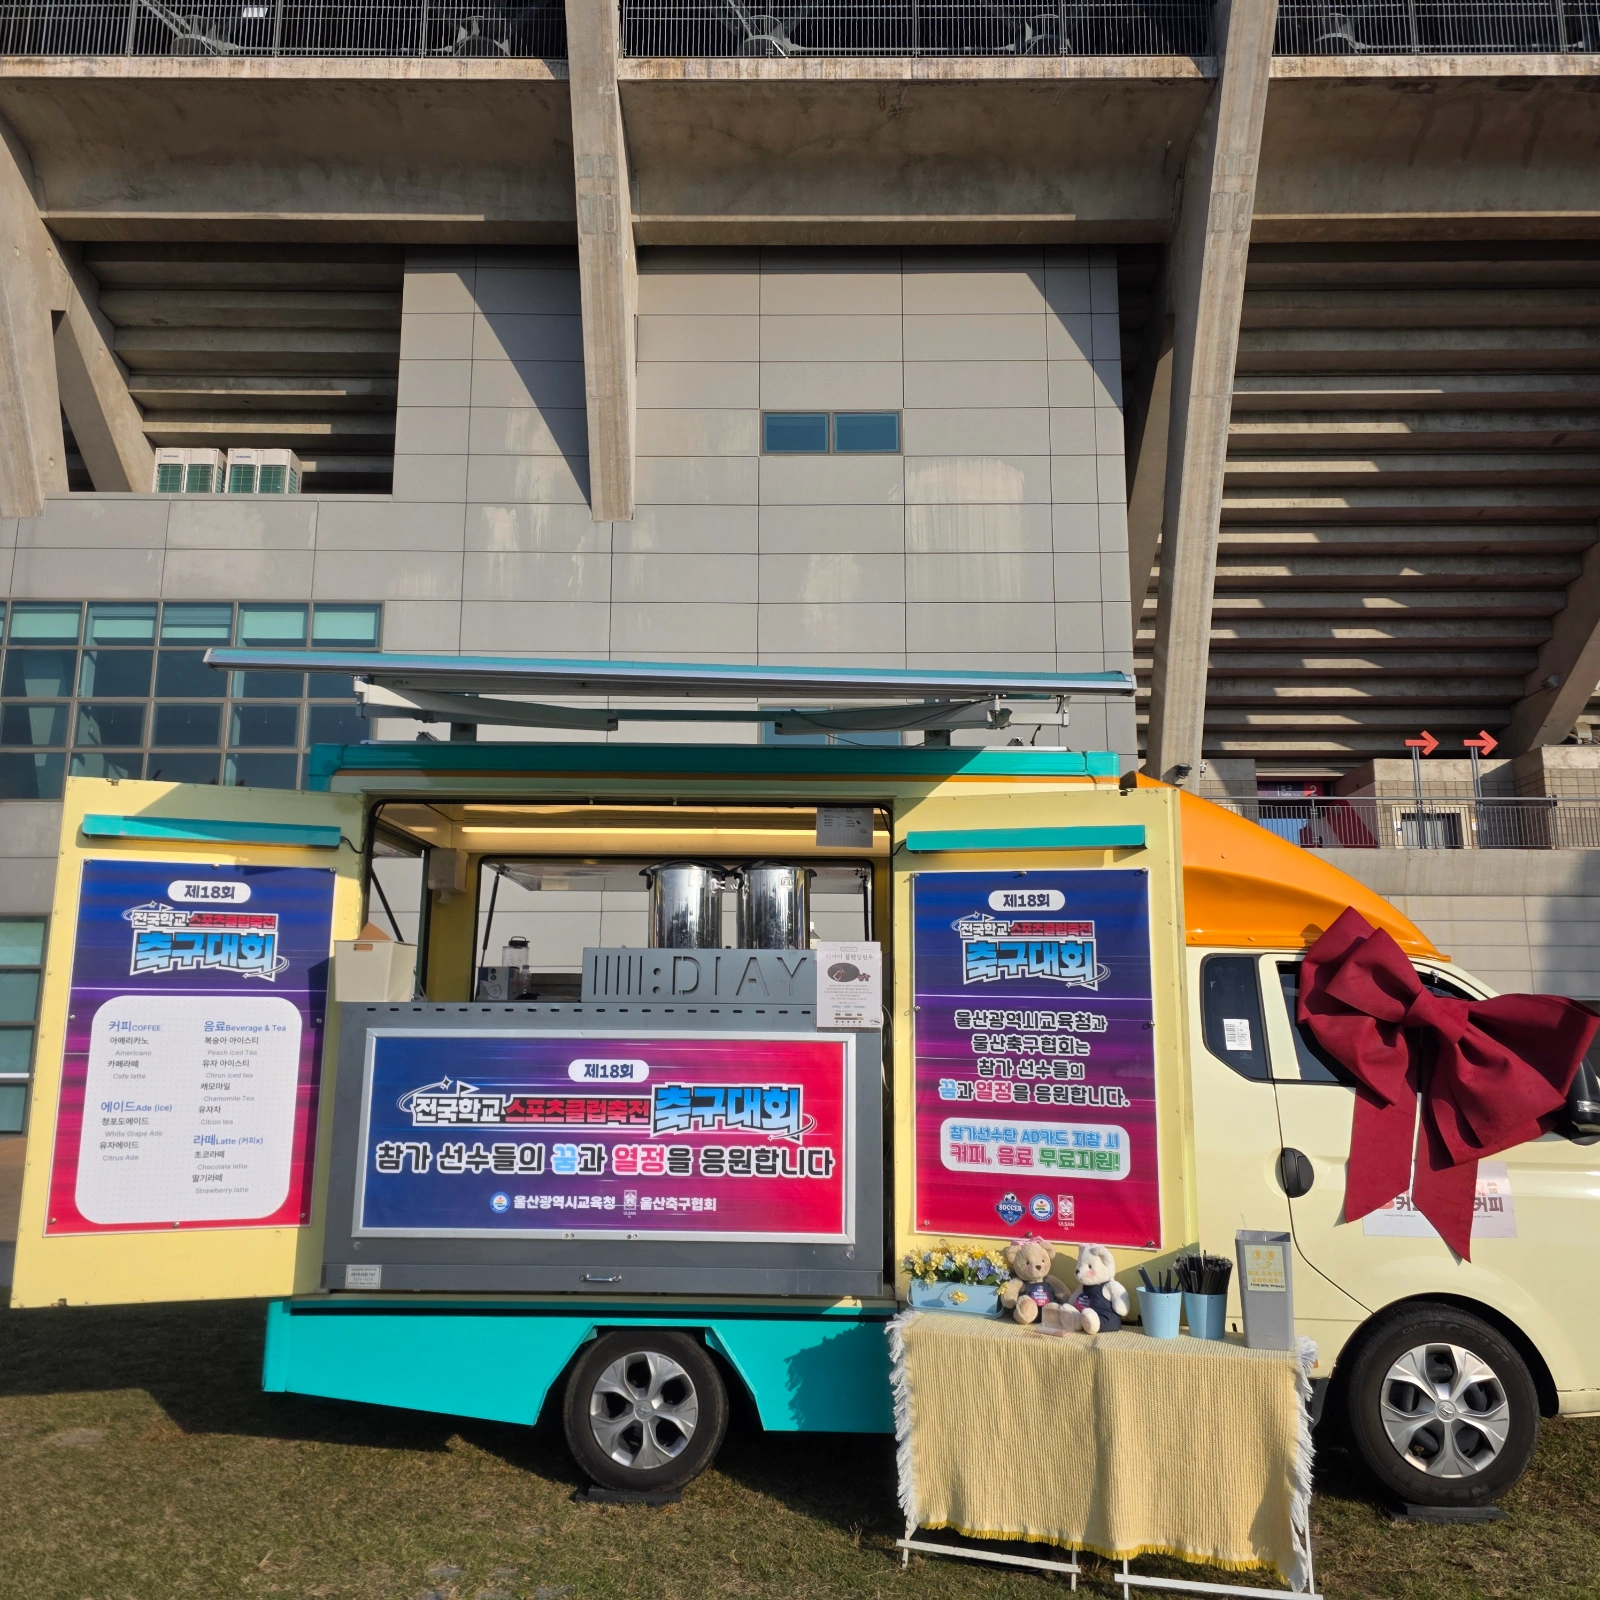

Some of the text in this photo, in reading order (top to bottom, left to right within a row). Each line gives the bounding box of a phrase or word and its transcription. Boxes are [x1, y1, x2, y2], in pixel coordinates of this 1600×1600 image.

[184, 884, 235, 900] 제18회
[1003, 893, 1050, 908] 제18회
[133, 912, 276, 929] 전국학교 스포츠클럽축전
[961, 922, 1092, 937] 전국학교 스포츠클럽축전
[136, 930, 273, 974] 축구대회
[966, 941, 1092, 982] 축구대회
[272, 1024, 286, 1032] Tea
[954, 1011, 1107, 1031] 울산광역시교육청과
[109, 1036, 149, 1045] 아메리카노
[205, 1036, 259, 1045] 복숭아 아이스티
[971, 1035, 1090, 1055] 울산축구협회는
[202, 1059, 250, 1068] 유자 아이스티
[584, 1063, 634, 1079] 제18회
[978, 1059, 1085, 1079] 참가 선수들의
[200, 1082, 231, 1091] 캐모마일
[939, 1080, 1131, 1107] 꿈과 열정을 응원합니다.
[154, 1104, 173, 1113] (ice)
[198, 1105, 221, 1114] 유자차
[415, 1086, 798, 1140] 전국학교 스포츠클럽축전 축구대회
[102, 1117, 149, 1126] 청포도에이드
[127, 1130, 147, 1138] Grape
[950, 1125, 1121, 1149] 참가선수단 AD카드 지참 시
[100, 1141, 139, 1150] 유자에이드
[193, 1150, 225, 1159] 초코라떼
[378, 1142, 833, 1177] 참가 선수들의 꿈과 열정을 응원합니다
[950, 1144, 1121, 1172] 커피, 음료 무료지원!
[192, 1174, 223, 1183] 딸기라떼
[195, 1187, 232, 1195] Strawberry
[514, 1195, 616, 1210] 울산광역시교육청
[640, 1197, 717, 1211] 울산축구협회
[999, 1204, 1022, 1212] SOCCER
